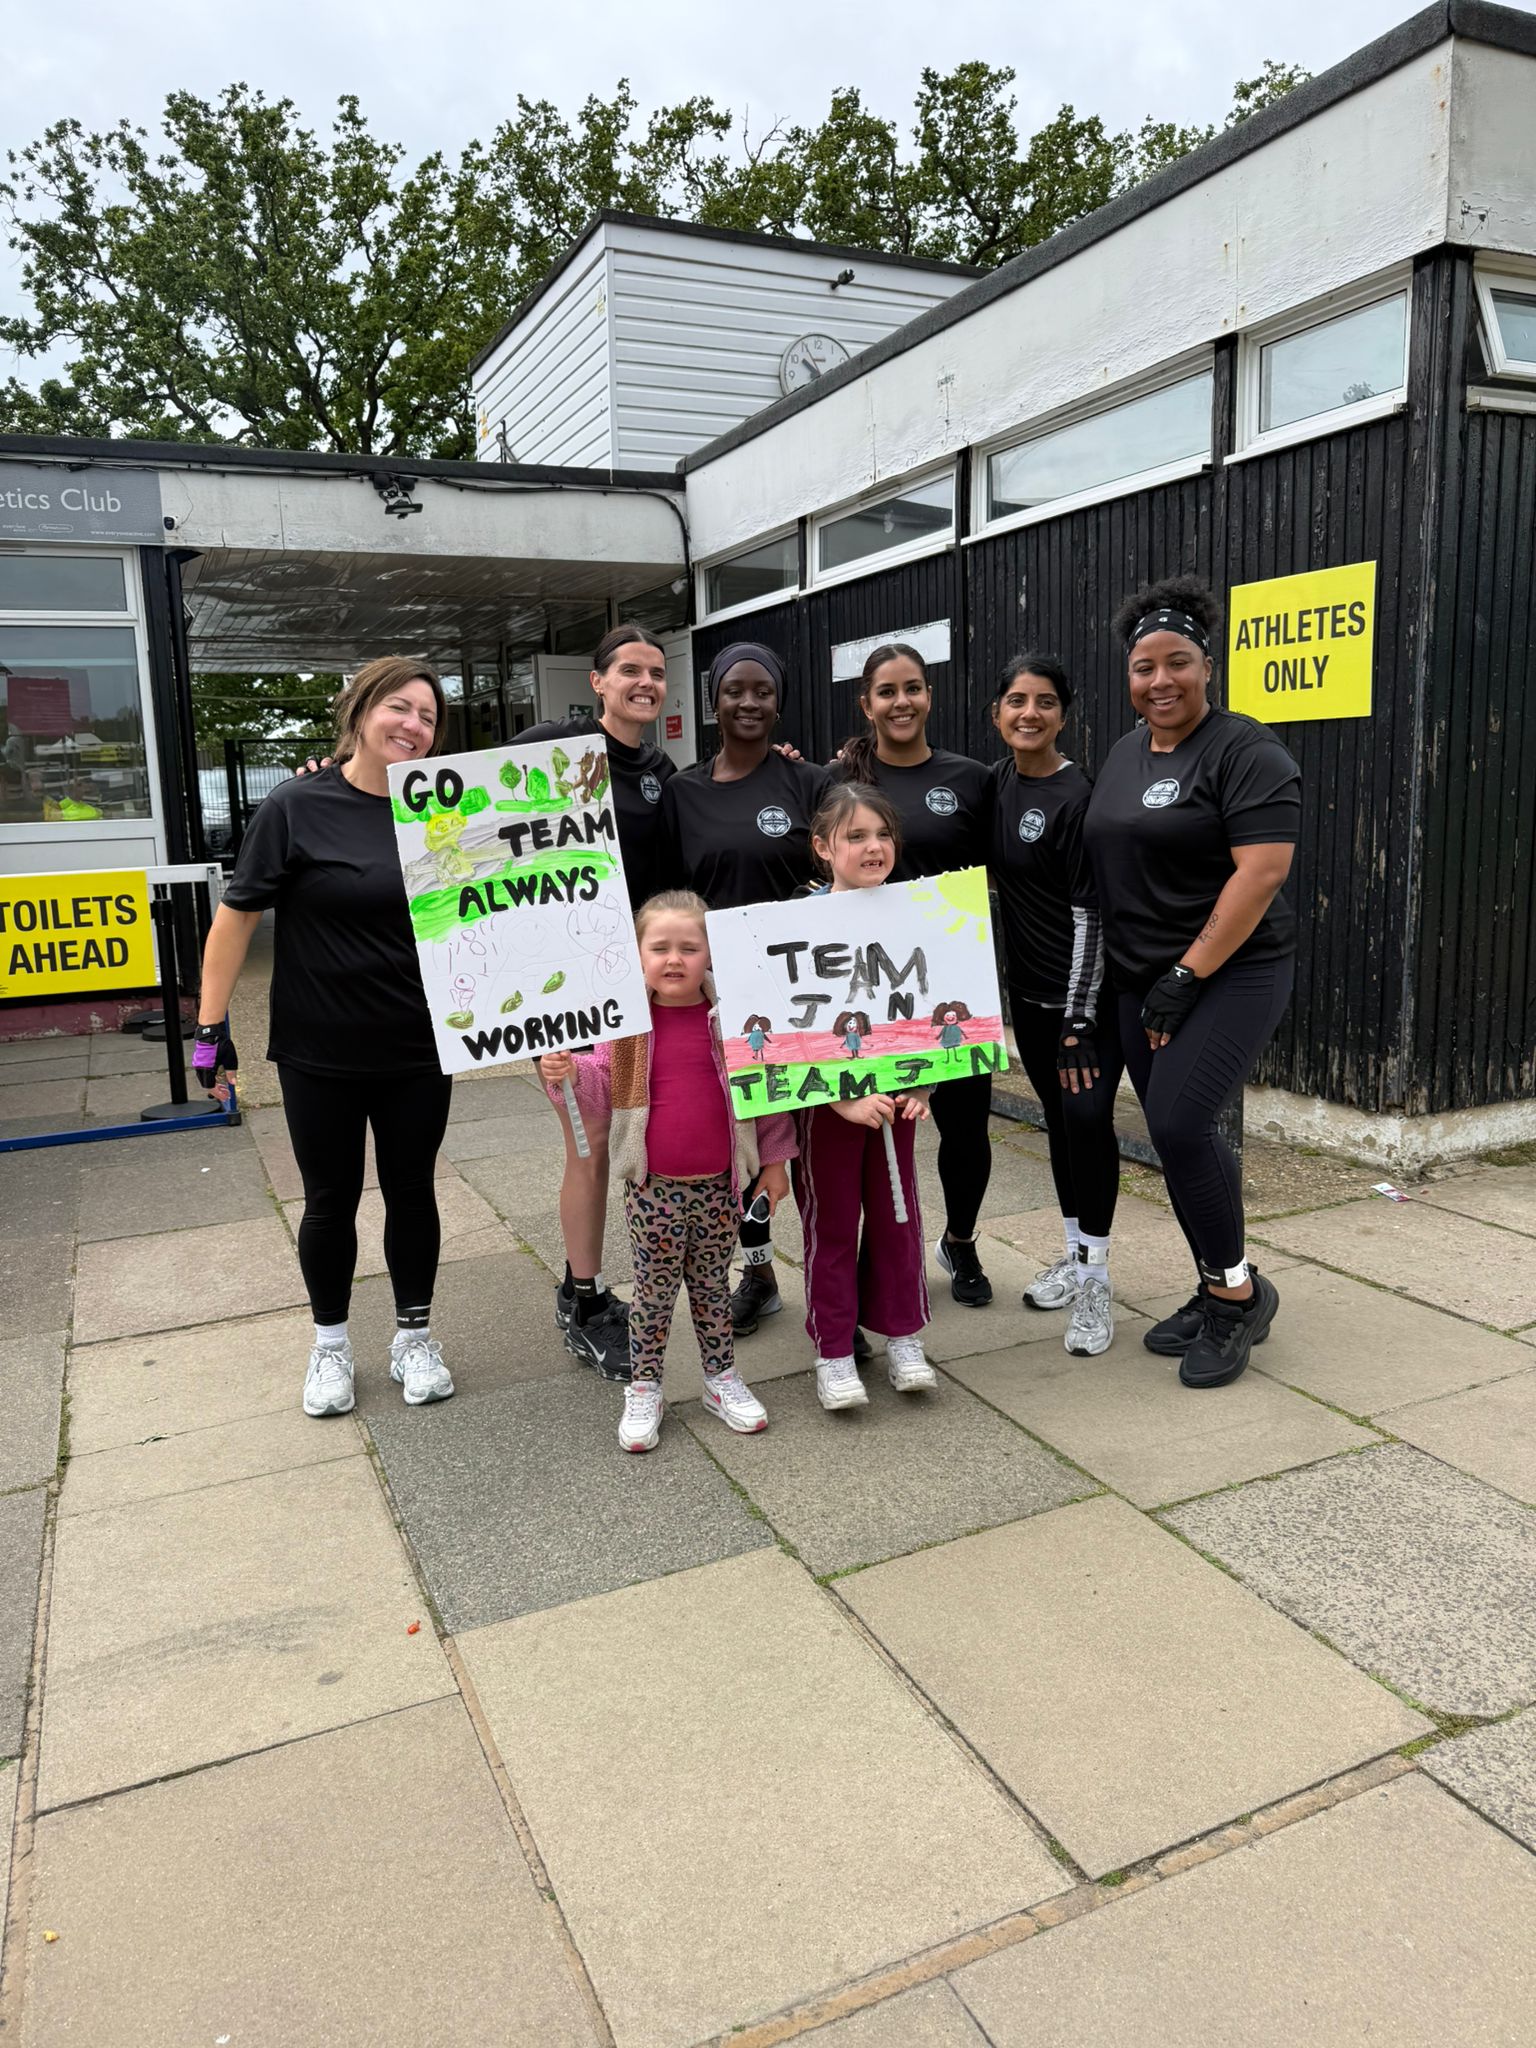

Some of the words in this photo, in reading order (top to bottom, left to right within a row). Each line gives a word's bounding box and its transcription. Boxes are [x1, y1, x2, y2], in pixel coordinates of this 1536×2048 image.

[790, 354, 800, 364] 10
[60, 488, 121, 513] Club
[1235, 601, 1366, 651] ATHLETES
[1263, 655, 1330, 693] ONLY
[402, 768, 464, 813] GO
[498, 808, 616, 858] TEAM
[458, 866, 600, 917] ALWAYS
[0, 894, 138, 933] TOILETS
[8, 937, 129, 976] AHEAD
[766, 941, 929, 1004] TEAM
[462, 998, 624, 1061] WORKING
[730, 1063, 880, 1102] TEAM
[752, 1249, 766, 1264] 85
